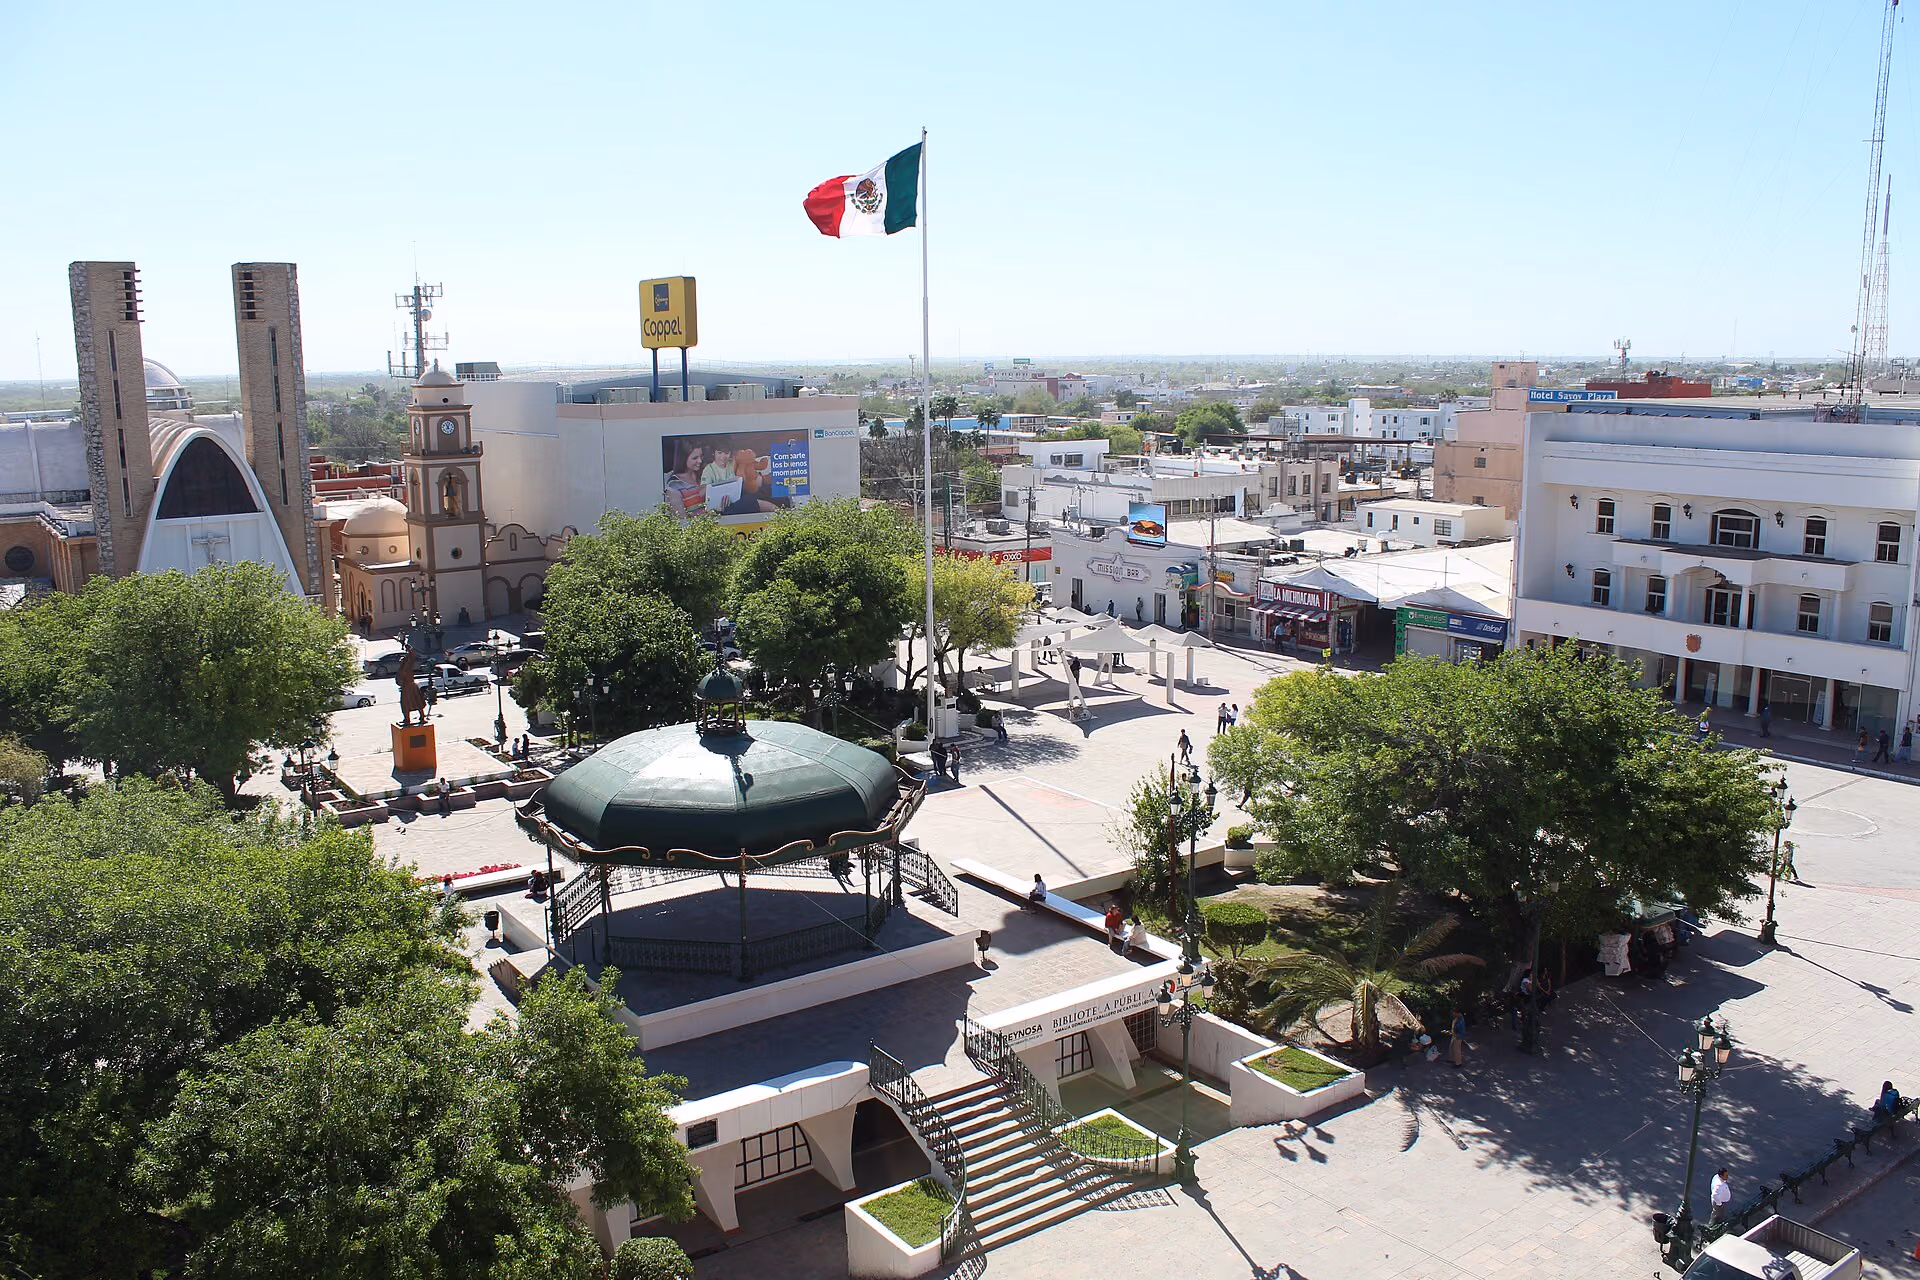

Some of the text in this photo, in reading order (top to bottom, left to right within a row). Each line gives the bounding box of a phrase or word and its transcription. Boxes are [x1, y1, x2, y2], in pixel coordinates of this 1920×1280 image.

[643, 316, 682, 342] Coppel
[1530, 391, 1612, 401] Hotel Savoy Plaza
[772, 468, 808, 477] momentos
[1002, 552, 1022, 561] OXXO
[1097, 563, 1140, 578] MISSION BAR
[1273, 587, 1321, 608] LA MICHOACANA
[1052, 1002, 1111, 1029] BIBLIOTEA
[1003, 1024, 1043, 1042] REYNOSA
